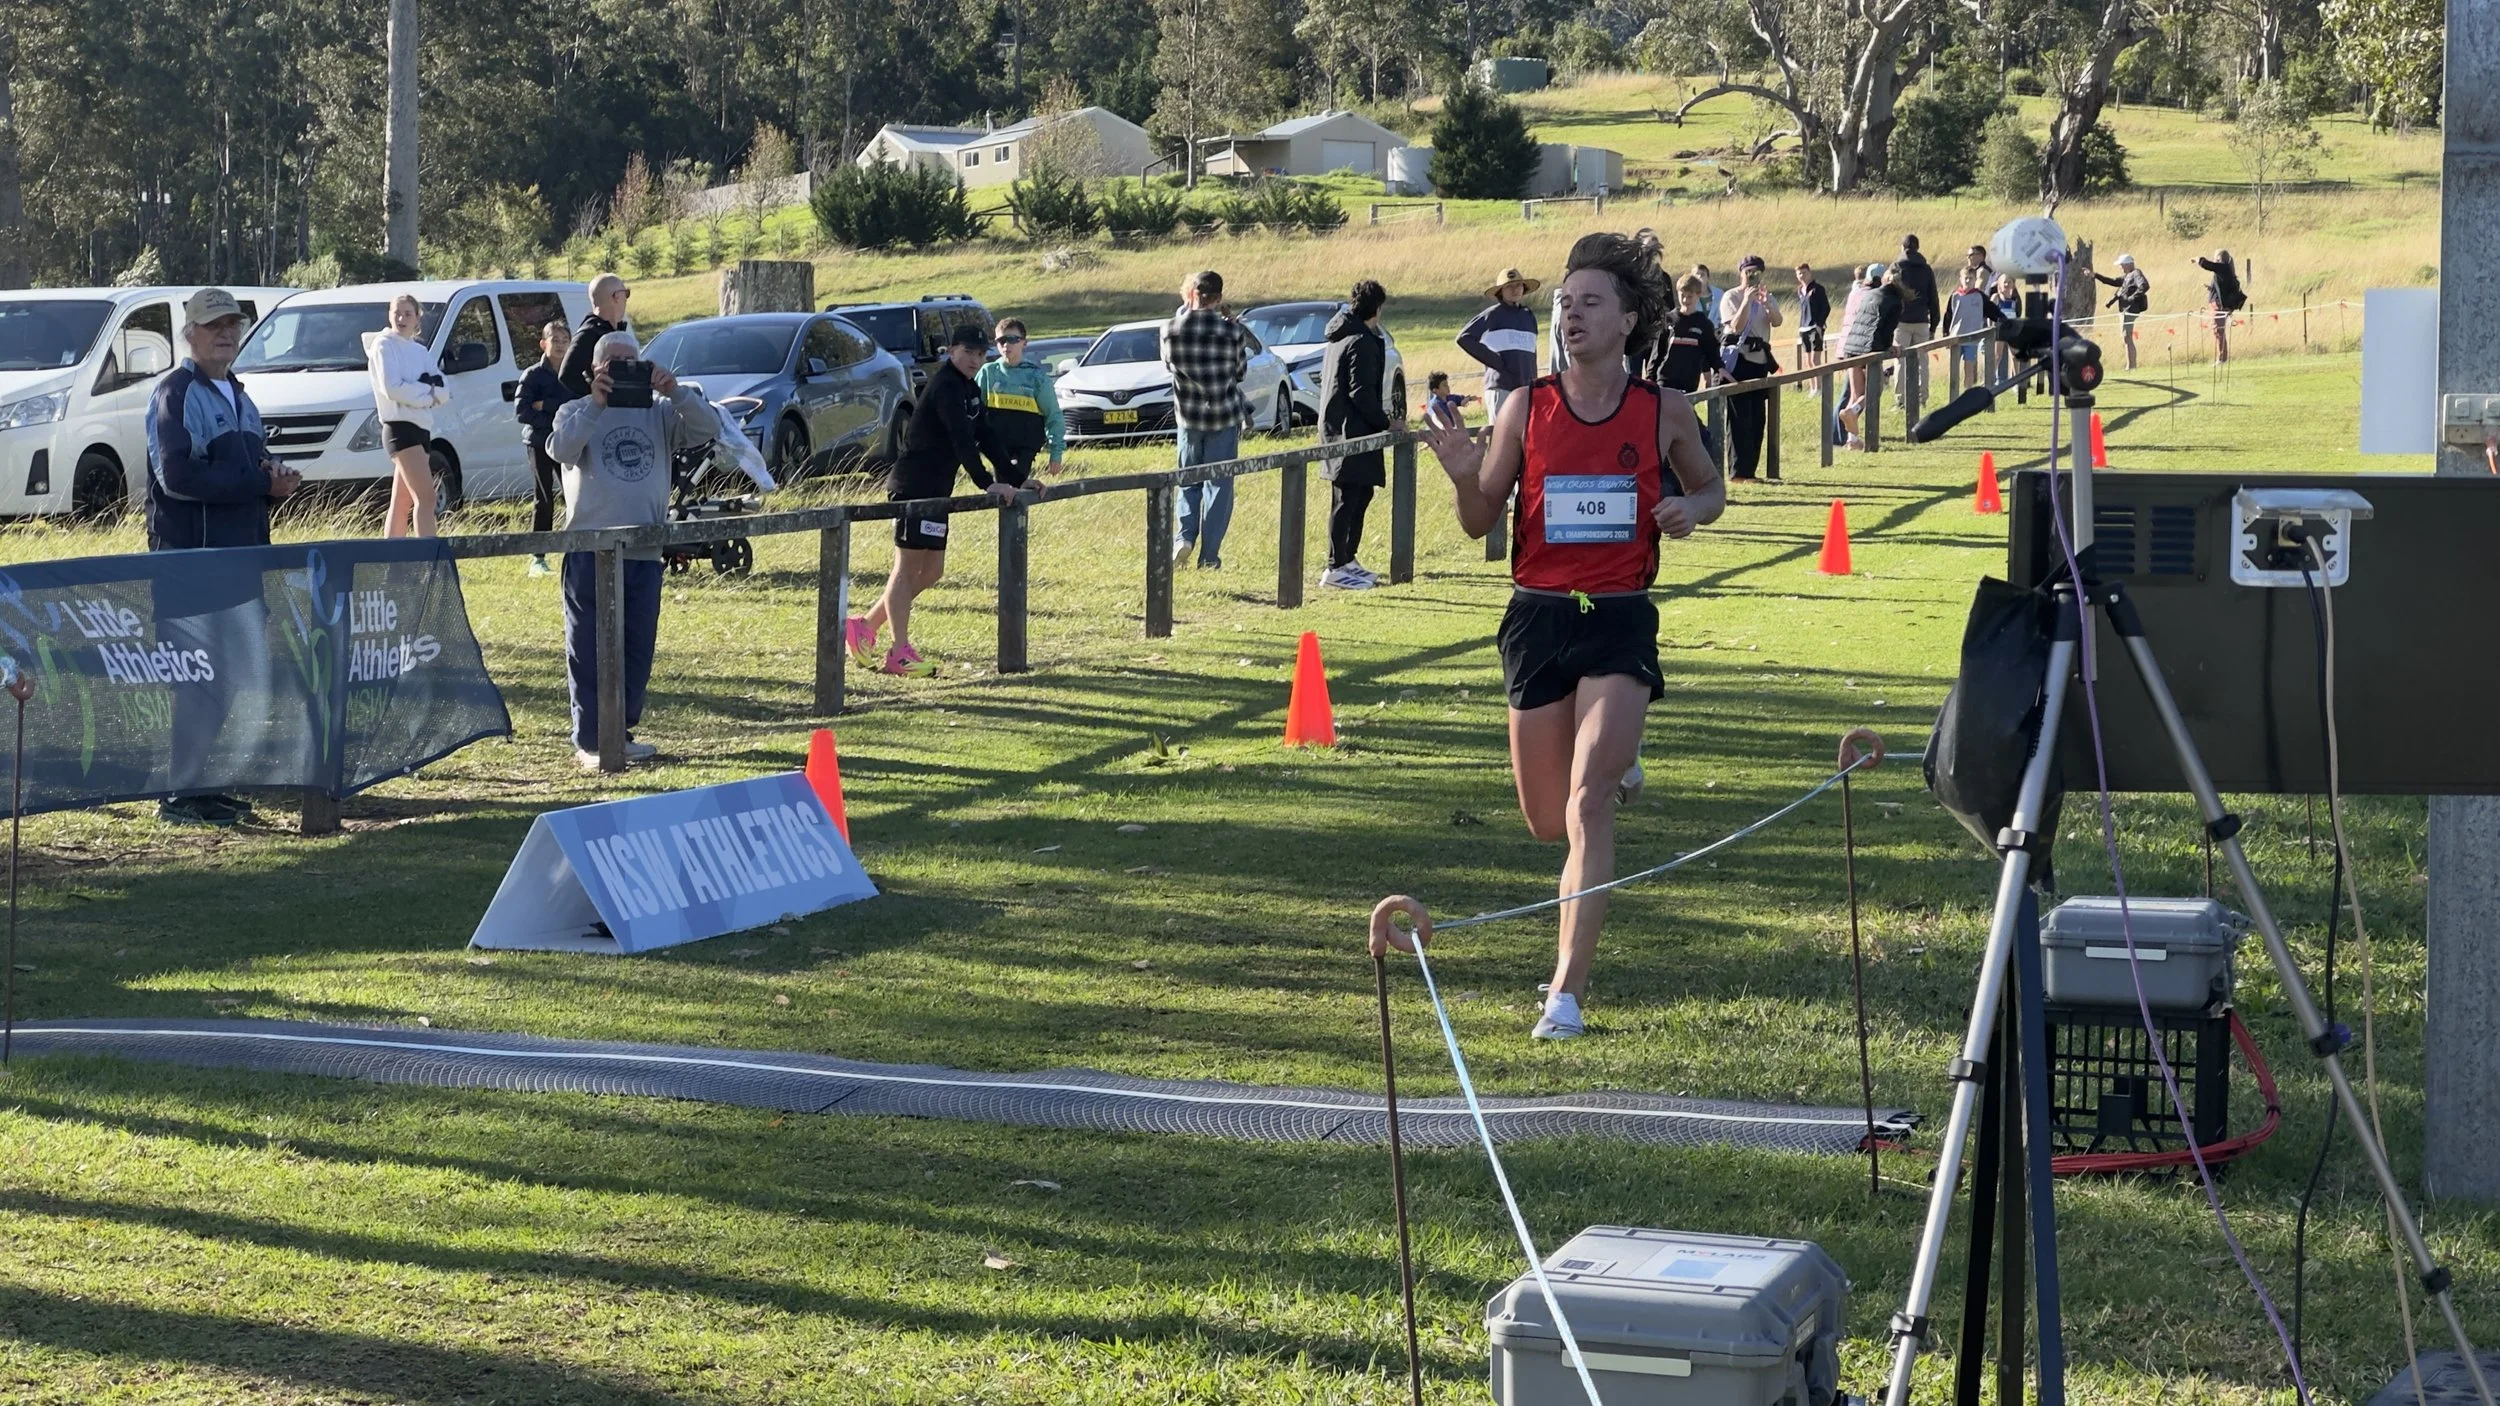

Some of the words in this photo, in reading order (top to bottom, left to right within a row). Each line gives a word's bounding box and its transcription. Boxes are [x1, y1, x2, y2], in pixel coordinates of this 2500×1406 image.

[1567, 479, 1595, 489] CROSS
[1597, 479, 1636, 489] COUNTRY
[1576, 501, 1606, 515] 408
[1565, 530, 1613, 538] CHAMPIONSHIPS
[60, 598, 143, 638] Little
[349, 589, 398, 633] Little
[97, 641, 215, 684] Athletics
[119, 689, 172, 730] NSW
[584, 829, 690, 921] NSW
[669, 801, 843, 904] ATHLETICS
